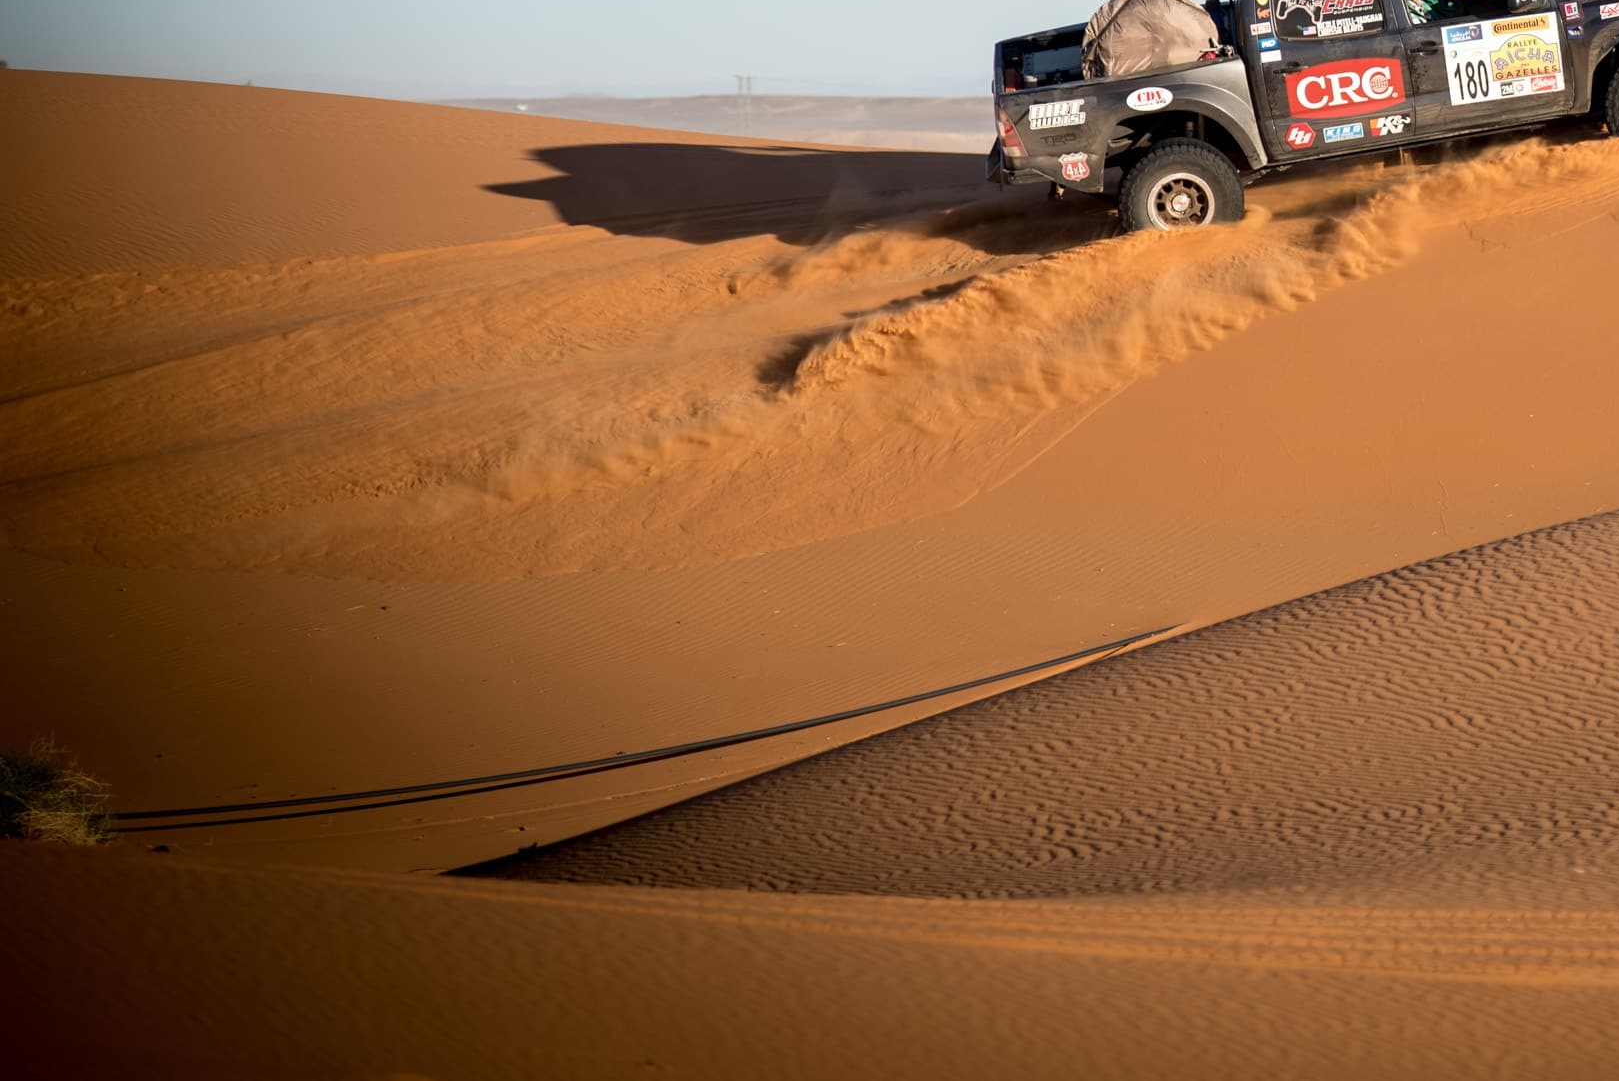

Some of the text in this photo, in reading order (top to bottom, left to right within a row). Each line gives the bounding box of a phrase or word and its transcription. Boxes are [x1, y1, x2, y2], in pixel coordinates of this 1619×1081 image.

[1493, 18, 1539, 34] Continental
[1507, 39, 1538, 48] RALLYE
[1454, 59, 1489, 100] 180
[1495, 65, 1558, 80] GAZELLES
[1296, 66, 1394, 109] CRC
